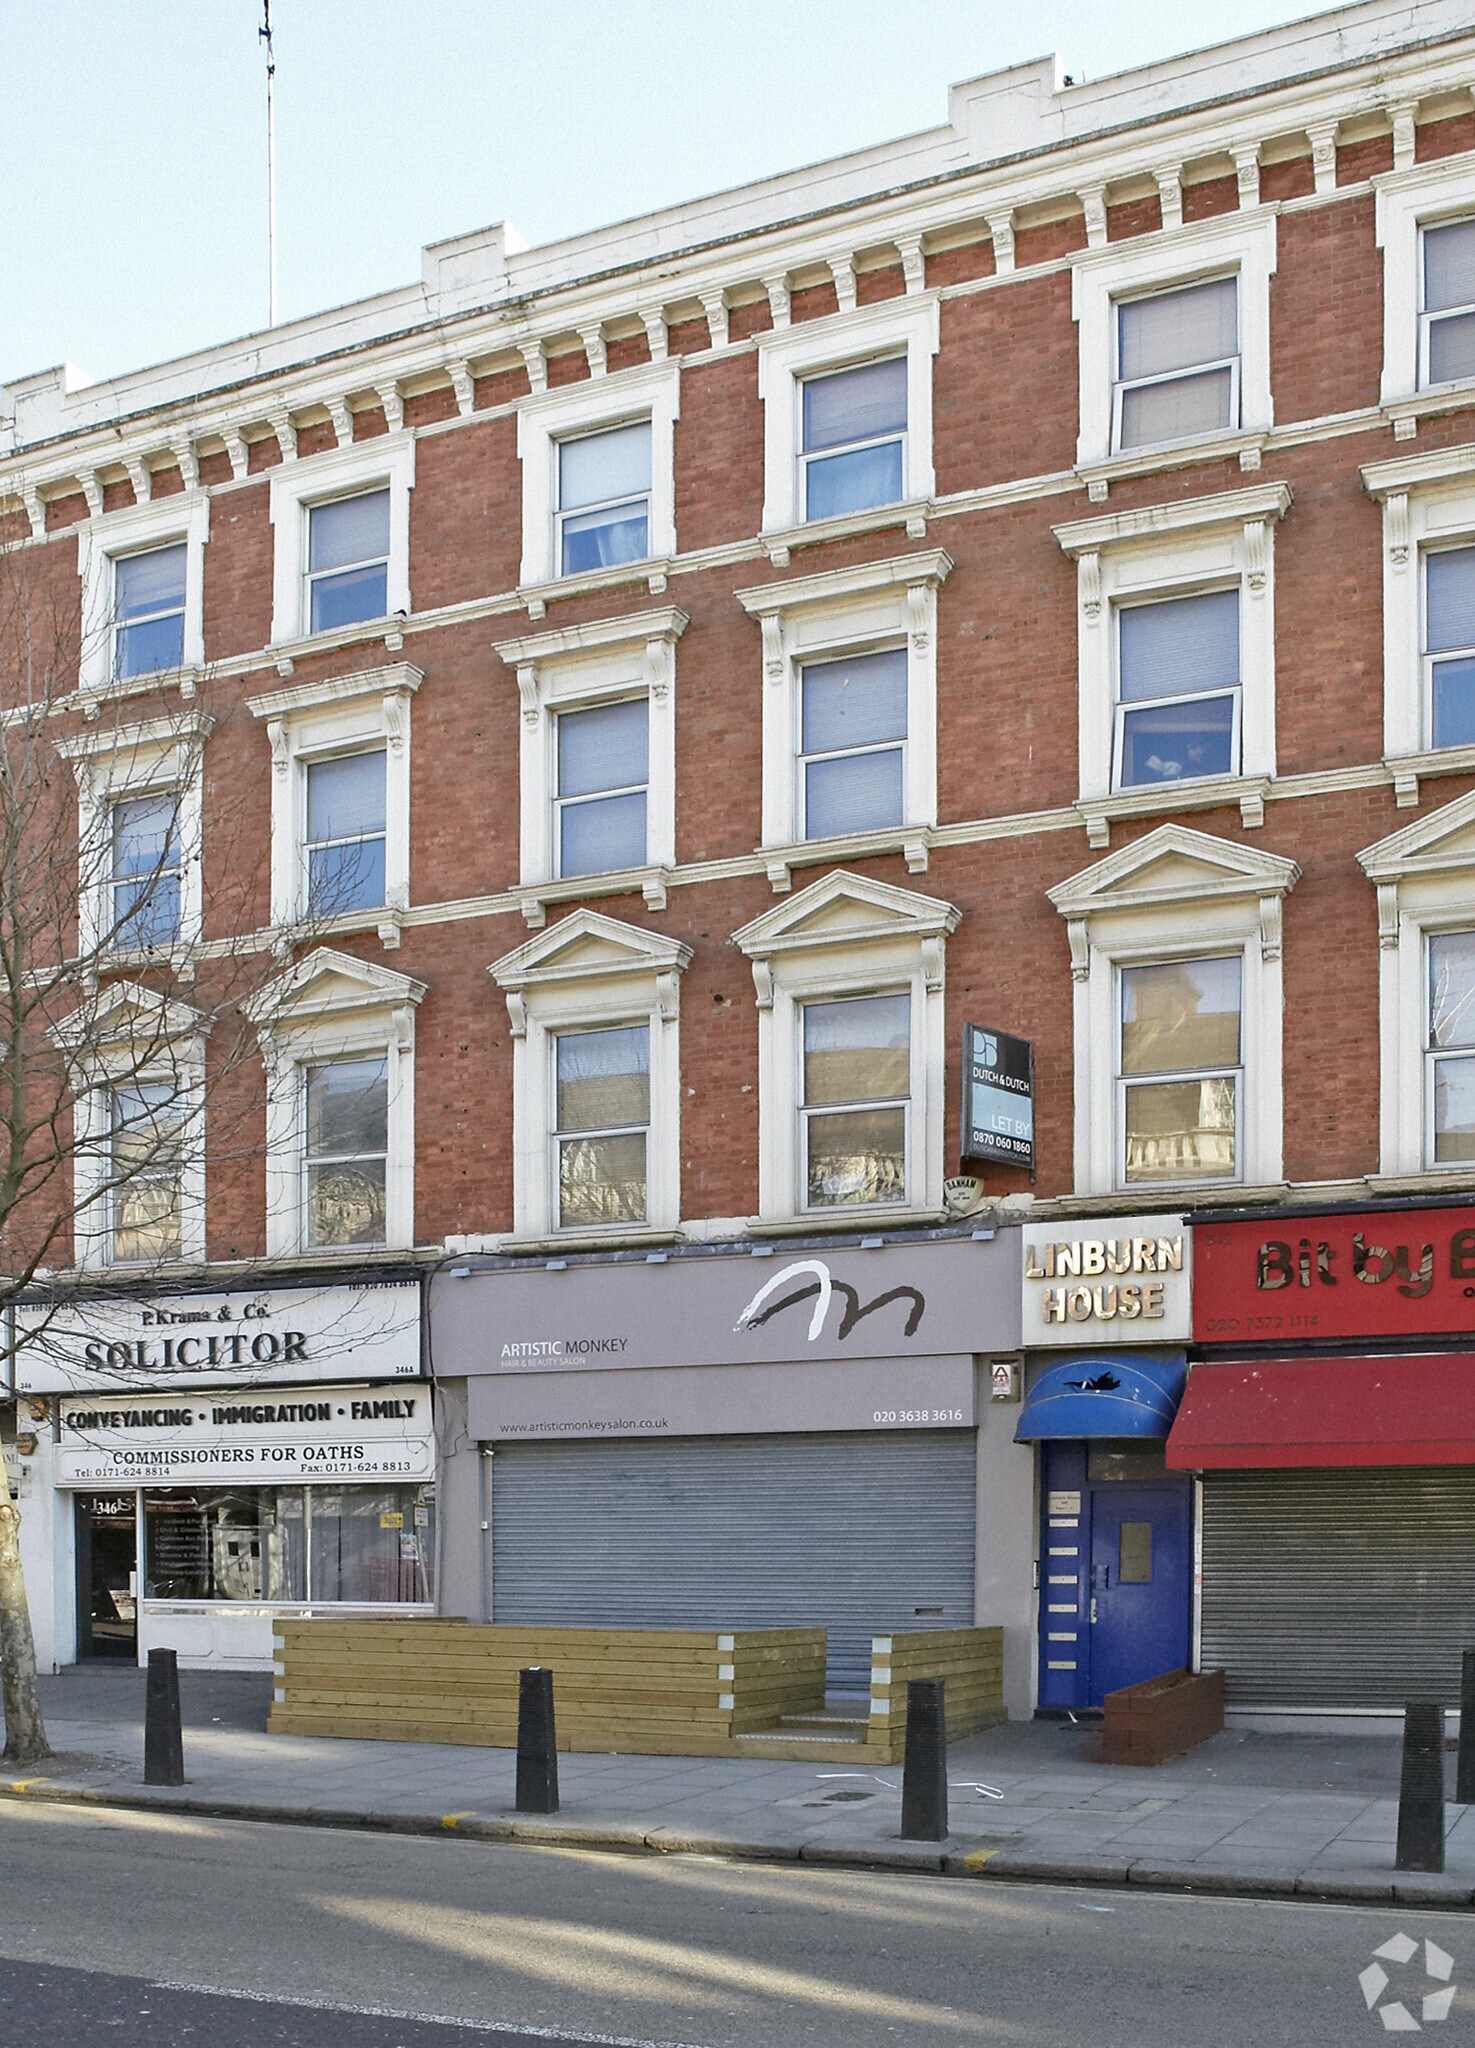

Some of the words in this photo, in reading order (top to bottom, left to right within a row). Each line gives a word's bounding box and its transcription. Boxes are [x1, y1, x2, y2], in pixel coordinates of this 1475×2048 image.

[973, 1066, 999, 1084] DUTCH
[999, 1074, 1006, 1088] &
[1005, 1076, 1030, 1093] DUTCH
[991, 1114, 1013, 1132] LET
[1015, 1120, 1031, 1137] BY
[973, 1131, 995, 1145] 0870
[995, 1136, 1012, 1149] 060
[1012, 1140, 1031, 1154] 1860
[1025, 1235, 1184, 1278] LINBURN
[1256, 1238, 1338, 1290] Bit
[1352, 1232, 1434, 1299] by
[217, 1304, 231, 1321] &
[1043, 1283, 1165, 1323] HOUSE
[1204, 1319, 1241, 1332] 020
[1246, 1317, 1283, 1329] 7372
[1289, 1314, 1319, 1328] 1114
[84, 1331, 309, 1371] SOLICITOR
[500, 1341, 562, 1357] ARTISTIC
[565, 1338, 628, 1354] MONKEY
[395, 1366, 415, 1374] 346A
[500, 1359, 519, 1369] HAIR
[519, 1359, 527, 1368] &
[528, 1358, 558, 1367] BEAUTY
[558, 1356, 586, 1366] SALON
[66, 1408, 193, 1428] CONVEYANCING
[212, 1402, 331, 1425] IMMIGRATION
[351, 1399, 416, 1420] FAMILY
[873, 1411, 897, 1422] 020
[899, 1409, 929, 1422] 3638
[931, 1409, 963, 1421] 3616
[500, 1417, 669, 1433] www.artisticmonkeysalon.co.uk
[113, 1448, 255, 1465] COMMISSIONERS
[260, 1448, 297, 1462] FOR
[303, 1445, 364, 1460] OATHS
[75, 1468, 93, 1477] Tel:
[95, 1467, 142, 1477] 0171-624
[145, 1467, 170, 1477] 8814
[301, 1463, 323, 1473] Fax:
[325, 1462, 378, 1473] 0171-624
[382, 1461, 411, 1472] 8813
[96, 1501, 118, 1515] 346
